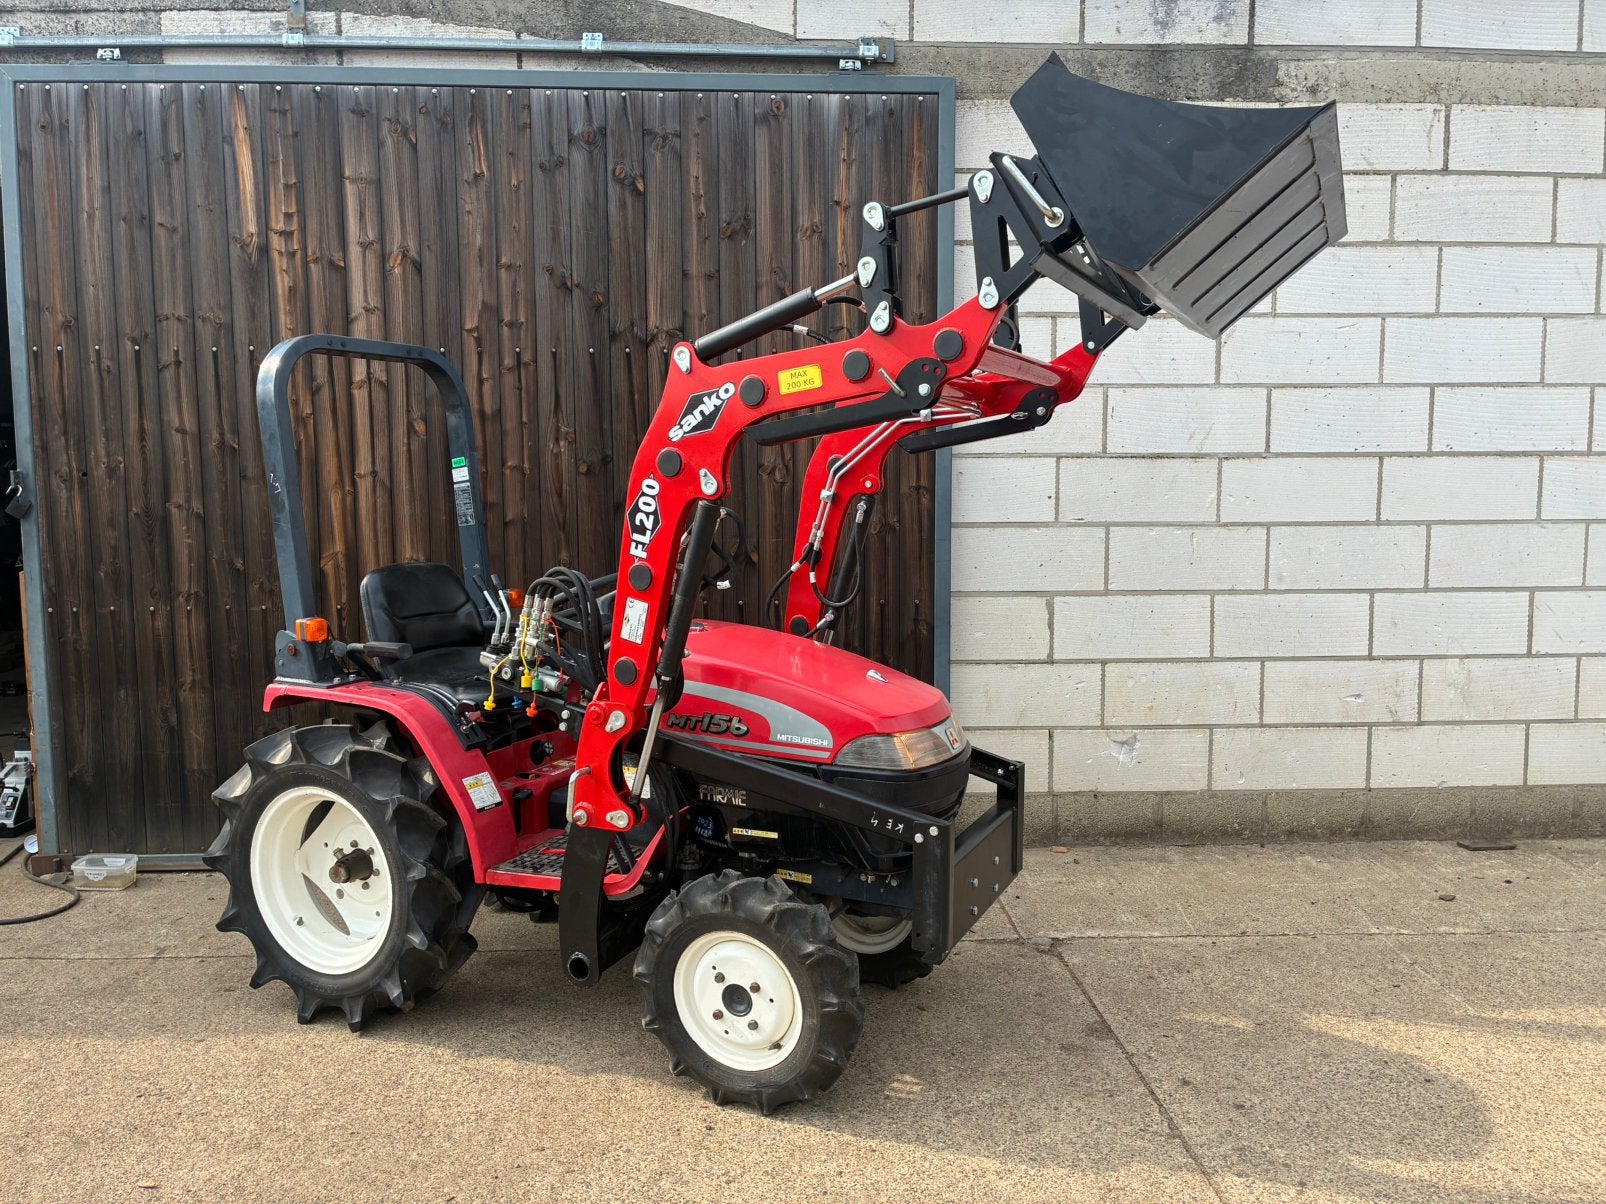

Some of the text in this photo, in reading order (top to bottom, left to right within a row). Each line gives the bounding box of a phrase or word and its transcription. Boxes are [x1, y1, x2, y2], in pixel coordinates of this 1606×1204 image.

[790, 369, 808, 379] MAX
[786, 378, 815, 390] 200 KG
[668, 382, 736, 442] sanko
[629, 478, 660, 559] FL200
[667, 712, 750, 737] MT156
[776, 733, 828, 746] MITSUBISHI
